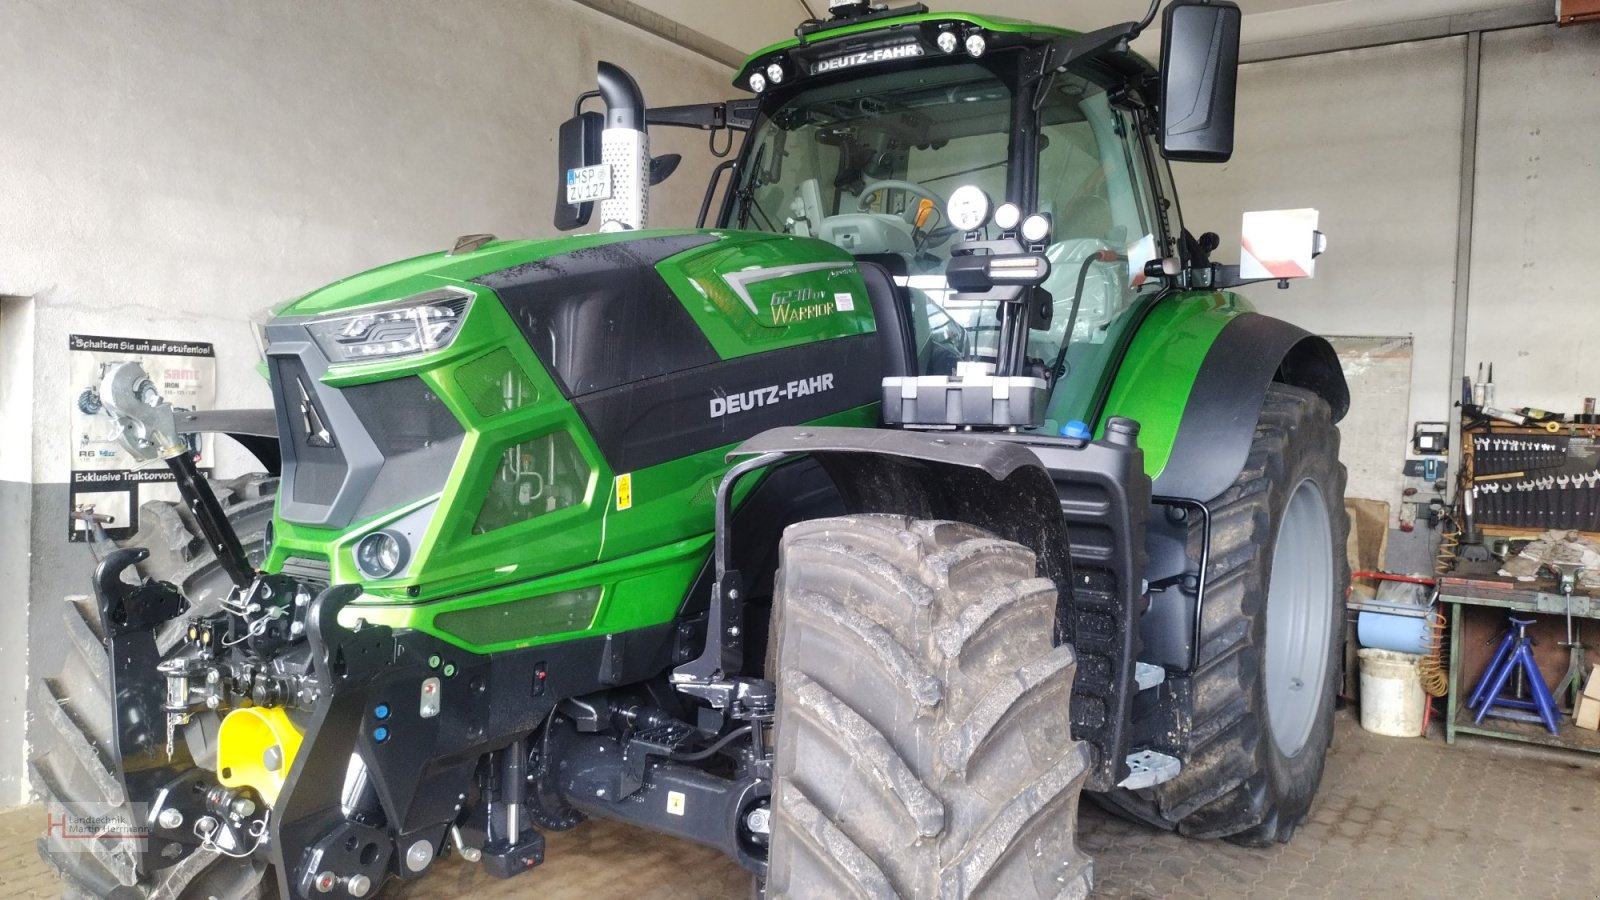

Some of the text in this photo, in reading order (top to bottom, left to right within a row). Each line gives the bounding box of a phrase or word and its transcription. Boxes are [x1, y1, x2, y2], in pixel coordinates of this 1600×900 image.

[818, 44, 917, 71] DEUTZ-FAHR
[574, 169, 594, 184] MSP
[571, 183, 605, 200] ZV 127
[76, 339, 119, 350] Schalten
[120, 341, 135, 351] Sie
[151, 343, 167, 353] auf
[709, 373, 834, 418] DEUTZ-FAHR
[75, 473, 121, 482] Exklusive
